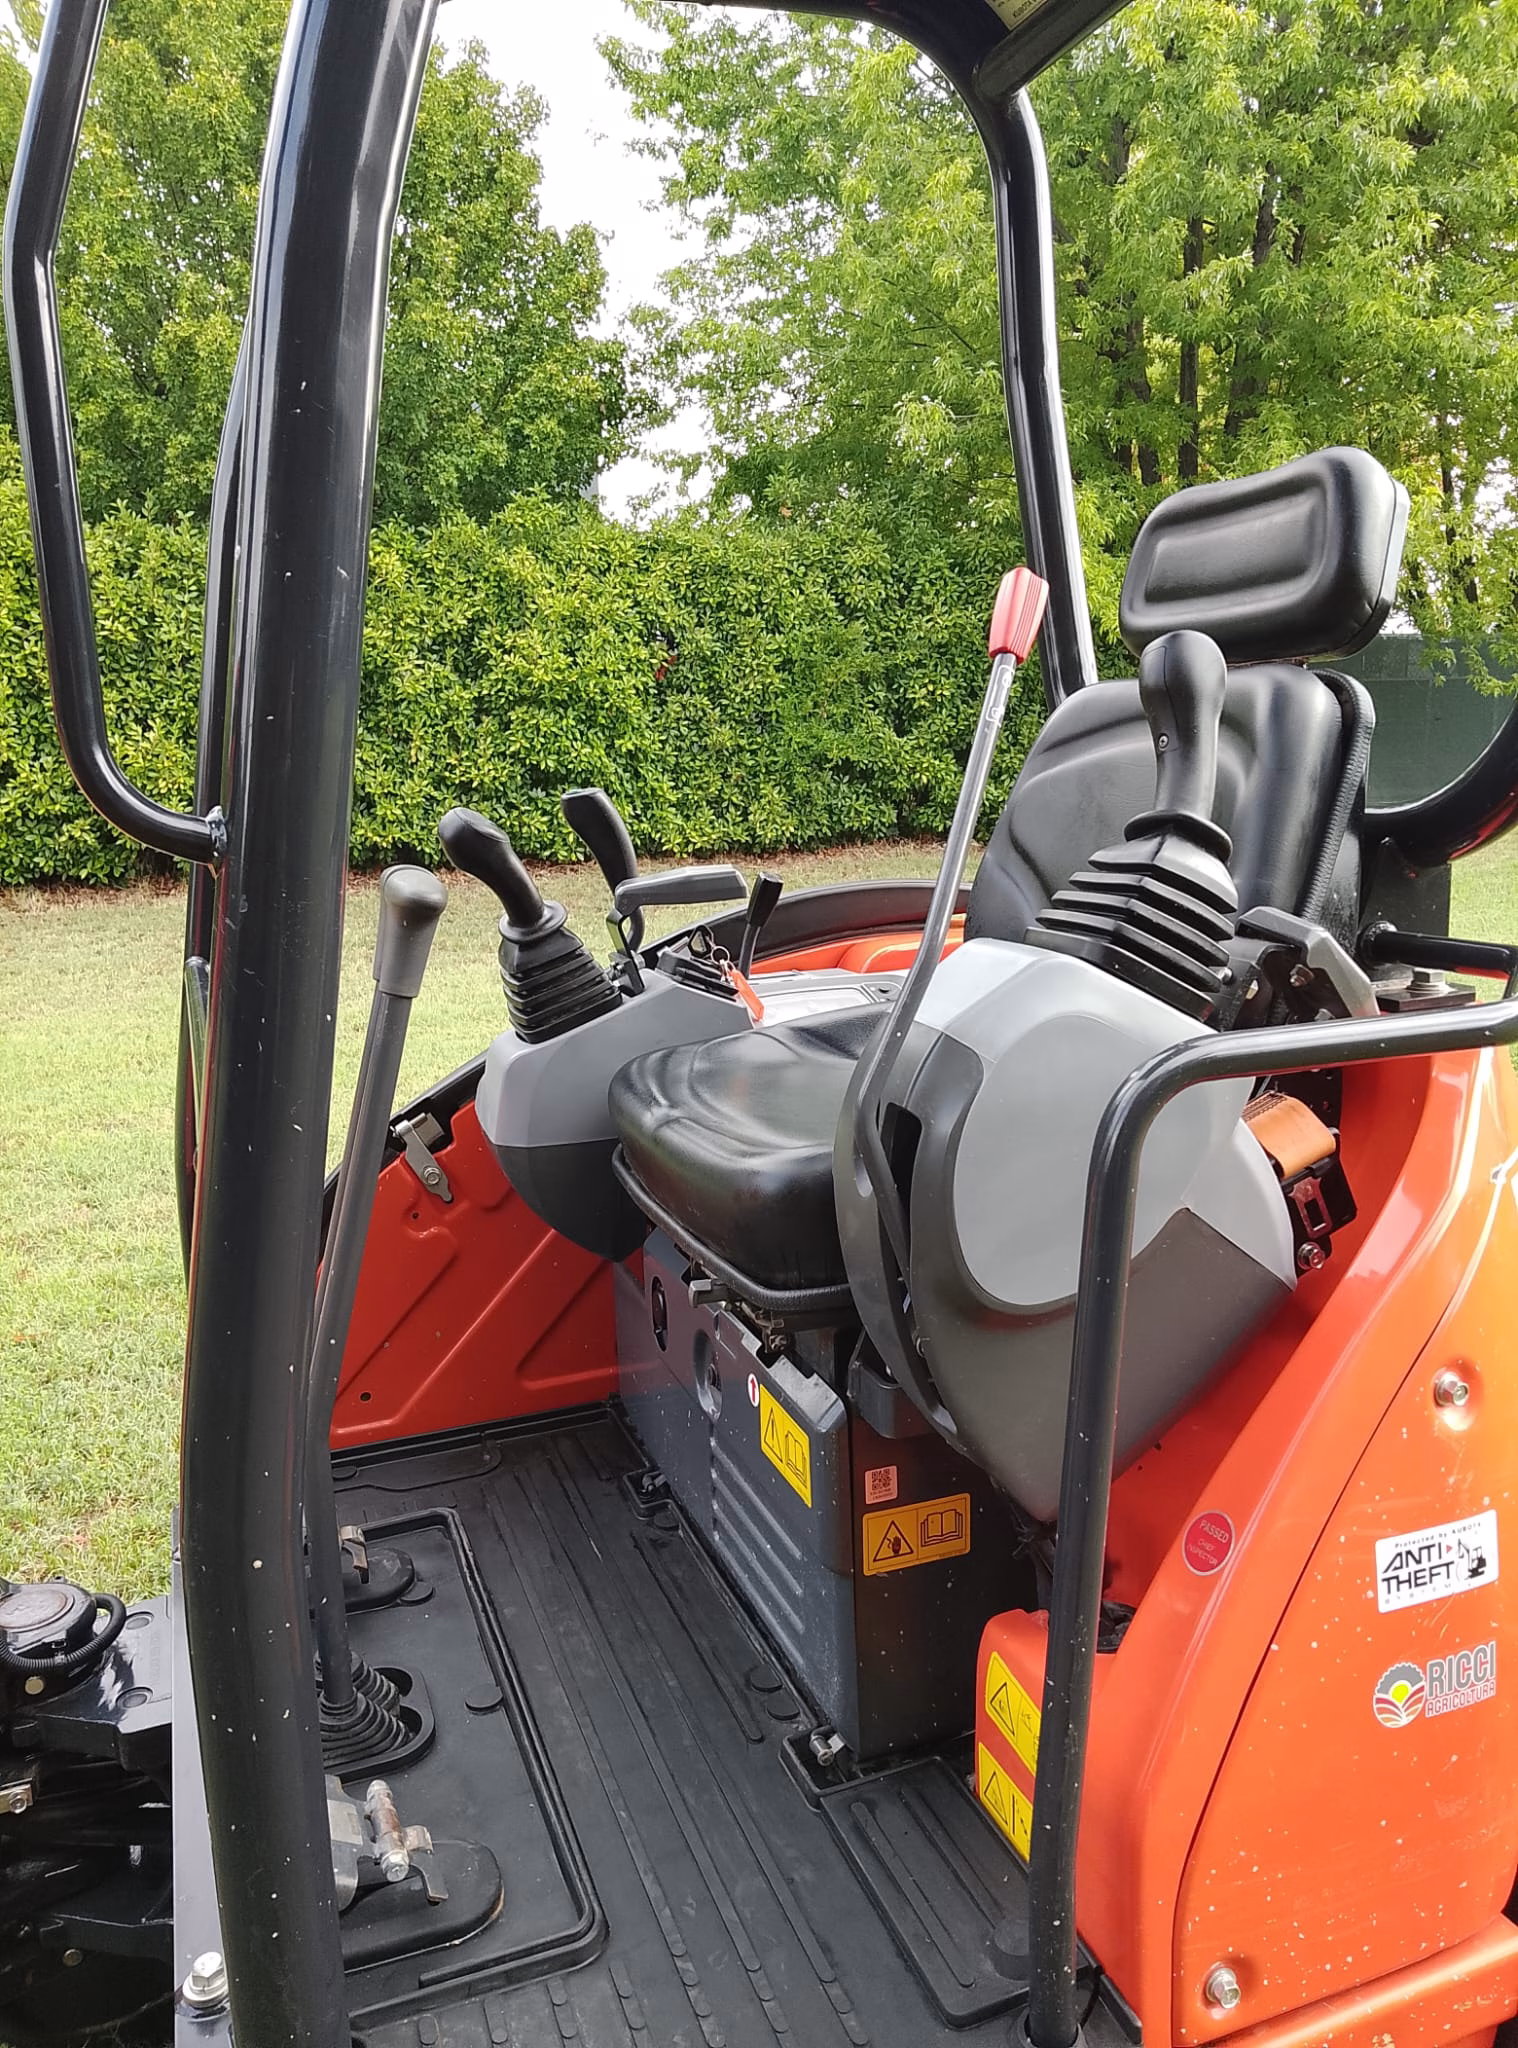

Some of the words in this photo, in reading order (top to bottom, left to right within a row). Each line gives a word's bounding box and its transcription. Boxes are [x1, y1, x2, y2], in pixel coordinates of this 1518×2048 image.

[1200, 1520, 1229, 1544] PASSED
[1382, 1542, 1443, 1574] ANTI
[1381, 1560, 1455, 1595] THEFT
[1427, 1640, 1496, 1699] RICCI
[1427, 1681, 1496, 1717] AGRICOLTURA
